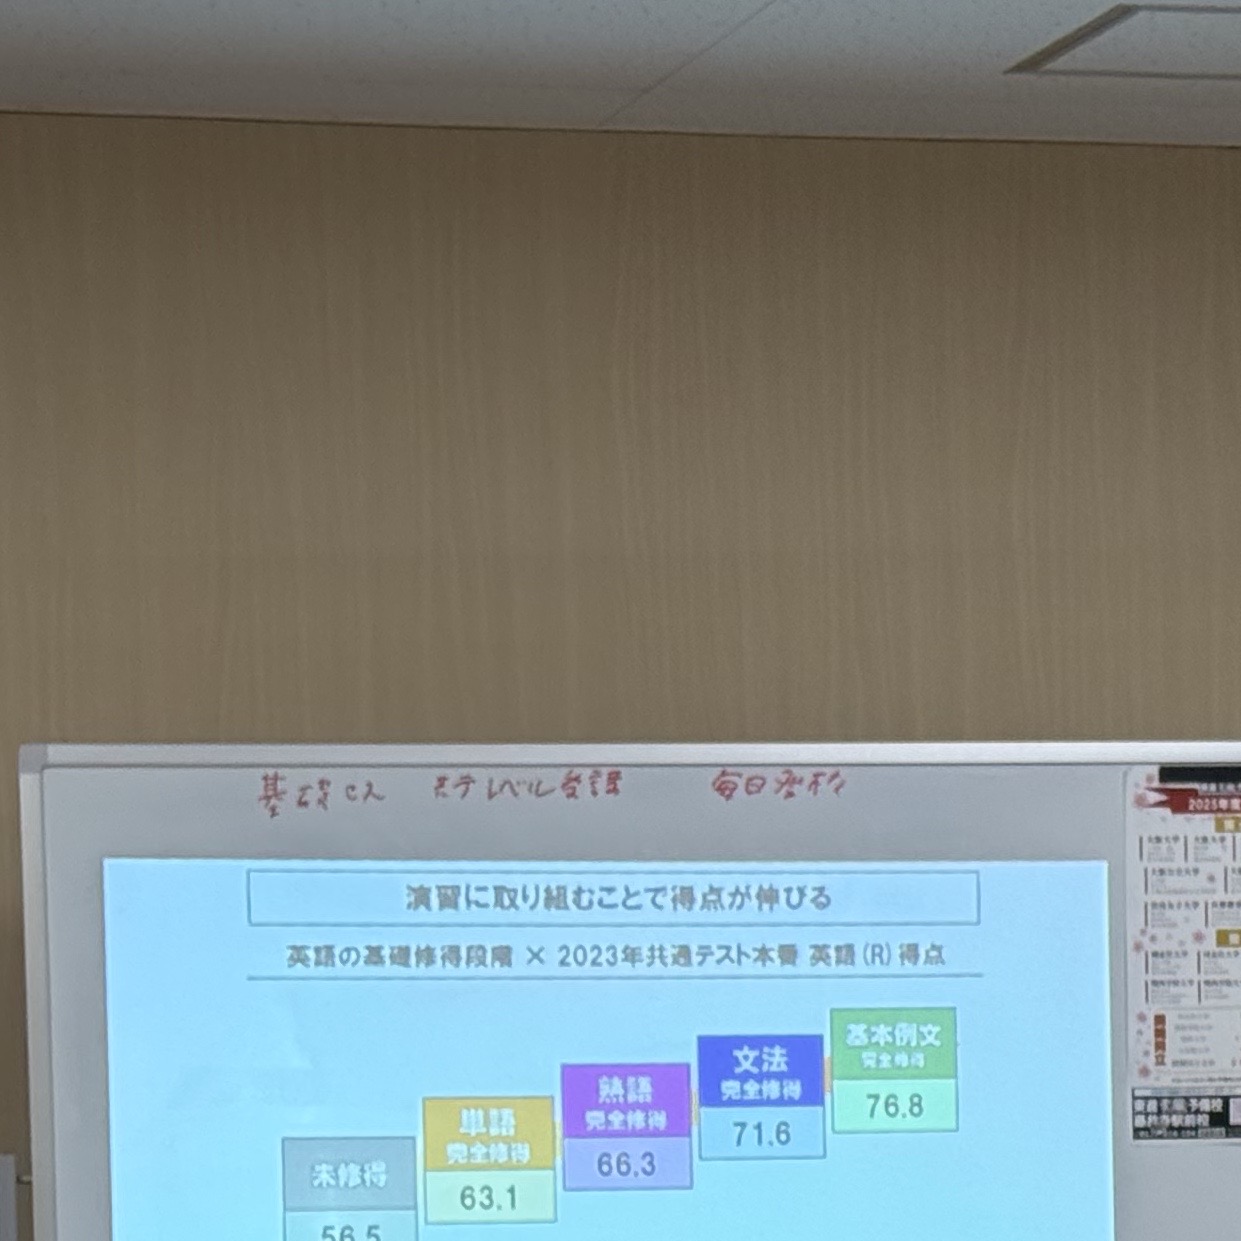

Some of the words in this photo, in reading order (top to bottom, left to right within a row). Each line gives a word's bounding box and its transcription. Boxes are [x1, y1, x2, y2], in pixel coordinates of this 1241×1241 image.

[405, 883, 832, 912] 演習に取り組むことで得点が伸びる
[845, 1022, 943, 1048] 基本例文
[732, 1044, 790, 1075] 文法
[719, 1078, 803, 1101] 完全修得
[584, 1109, 669, 1132] 完全修得
[866, 1093, 925, 1120] 76.8
[732, 1120, 792, 1148] 71.6
[445, 1141, 532, 1165] 完全修得
[596, 1150, 657, 1178] 66.3
[310, 1160, 389, 1190] 未修得
[459, 1184, 518, 1212] 63.1
